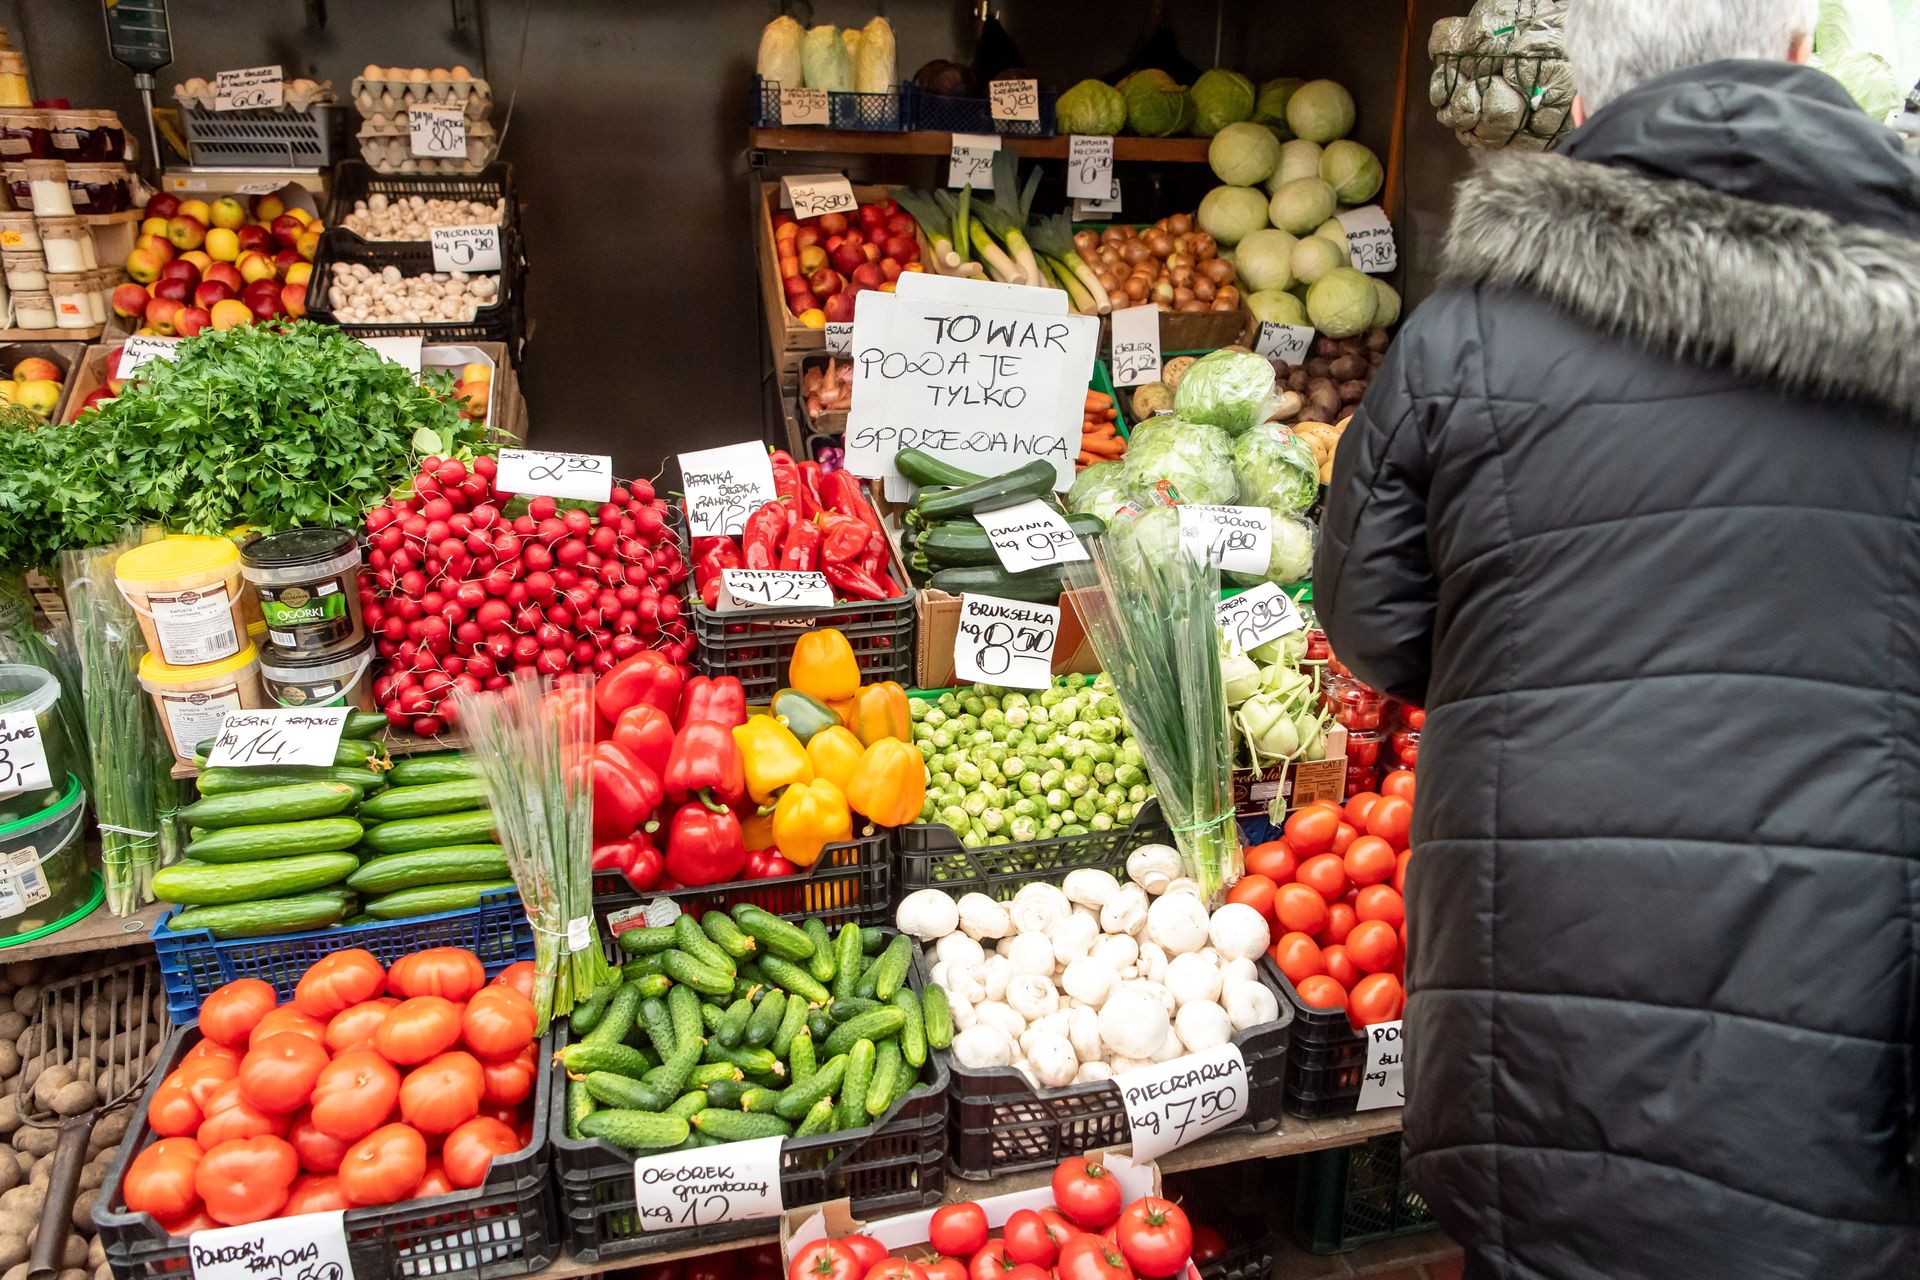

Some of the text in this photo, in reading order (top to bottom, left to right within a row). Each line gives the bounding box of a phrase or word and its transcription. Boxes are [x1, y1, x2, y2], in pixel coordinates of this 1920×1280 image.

[924, 314, 1070, 353] TOWAR
[927, 385, 1027, 409] TYLKO
[850, 426, 1070, 460] SPRZEDAWCA
[995, 540, 1020, 551] kg
[730, 571, 823, 580] PAPRYKA
[729, 582, 755, 592] kg
[277, 607, 325, 621] OGÓRKI
[968, 602, 1054, 626] BRUKSELKA
[961, 621, 983, 644] kg
[225, 716, 277, 728] OGÓRKI
[1126, 1059, 1242, 1106] PIECZARKA
[1366, 1071, 1387, 1087] kg
[1131, 1112, 1160, 1135] kg
[643, 1166, 734, 1184] OGÓREK
[641, 1206, 673, 1222] kg
